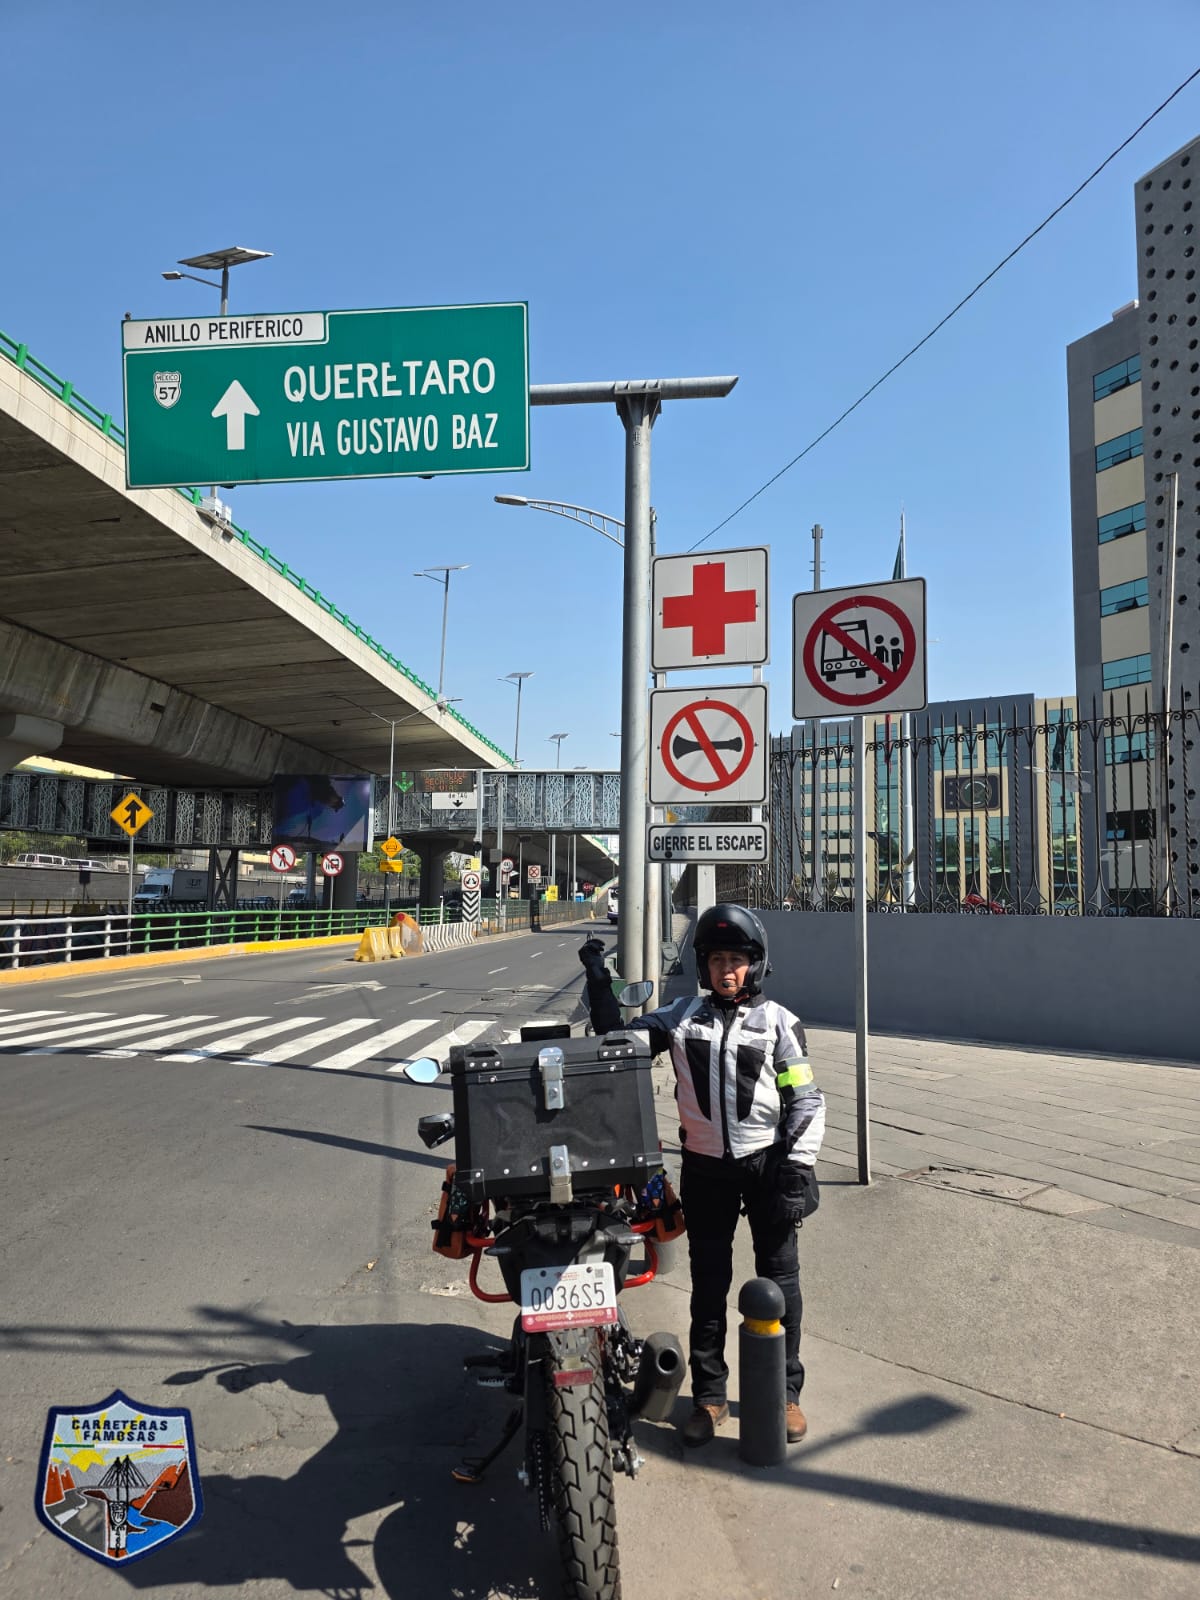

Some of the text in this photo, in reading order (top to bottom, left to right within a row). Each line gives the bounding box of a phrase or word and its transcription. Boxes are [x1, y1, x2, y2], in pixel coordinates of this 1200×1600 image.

[144, 317, 303, 344] ANILLO PERIFERICO
[159, 386, 178, 400] 57
[283, 357, 496, 403] QUERETARO
[286, 412, 499, 457] VIA GUSTAVO BAZ
[698, 835, 713, 851] EL
[716, 835, 763, 851] ESCAPE
[531, 1282, 605, 1312] 0036S5
